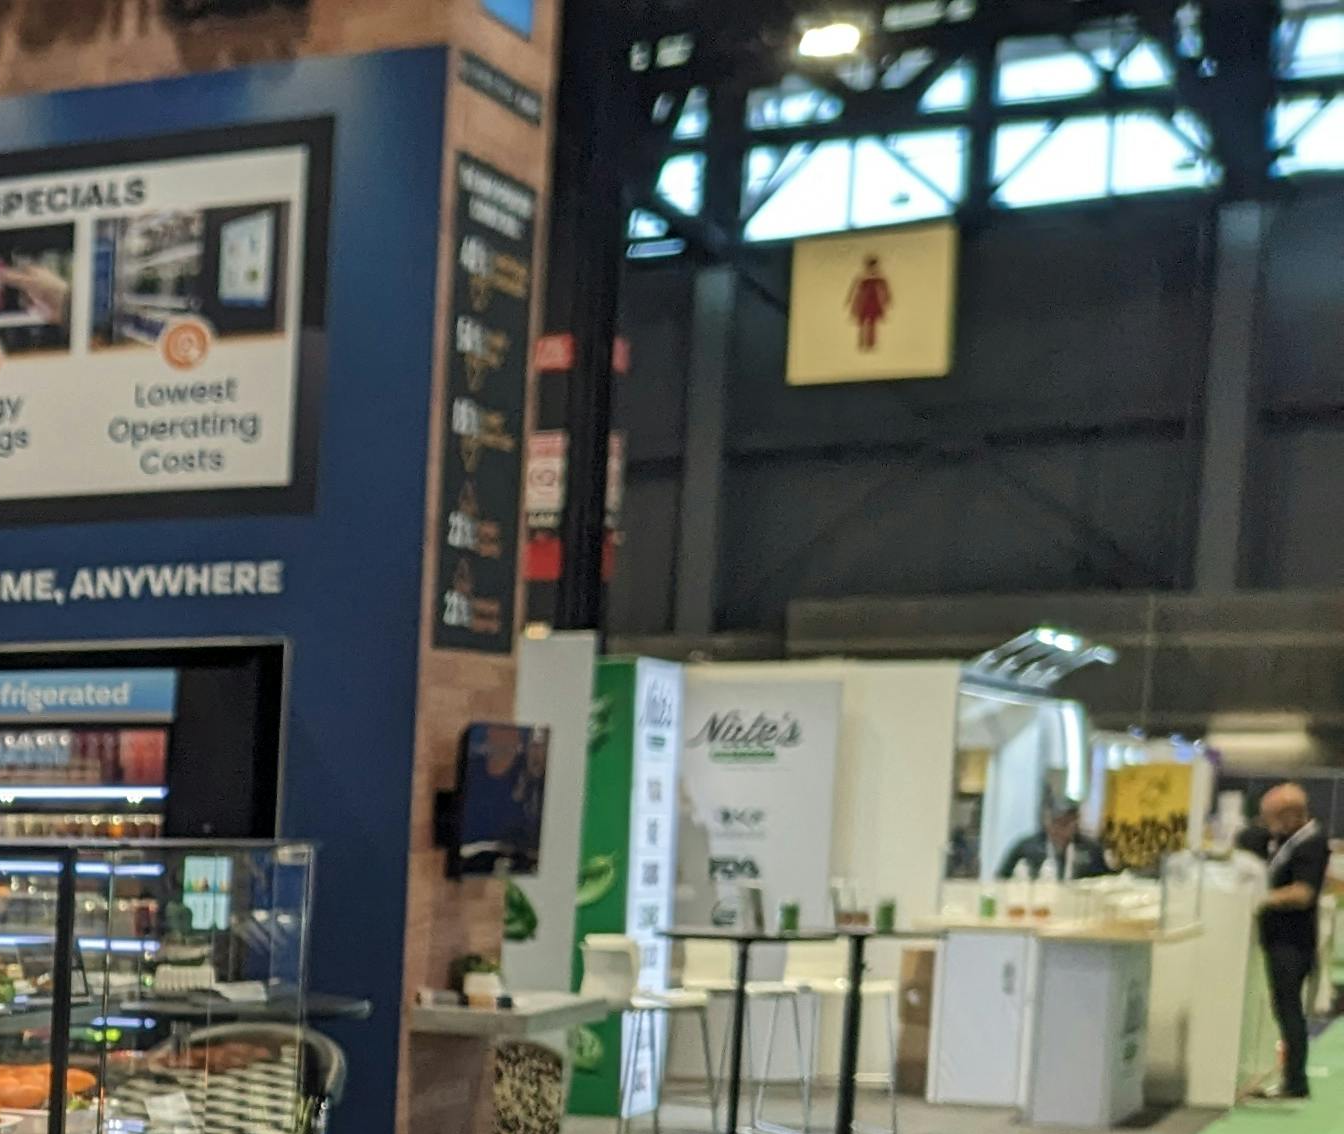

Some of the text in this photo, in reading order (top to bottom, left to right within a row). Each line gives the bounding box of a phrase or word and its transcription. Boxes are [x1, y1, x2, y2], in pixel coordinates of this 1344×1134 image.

[133, 377, 239, 409] Lowest
[107, 410, 261, 446] Operating
[139, 450, 224, 477] Costs
[69, 561, 282, 599] ANYWHERE
